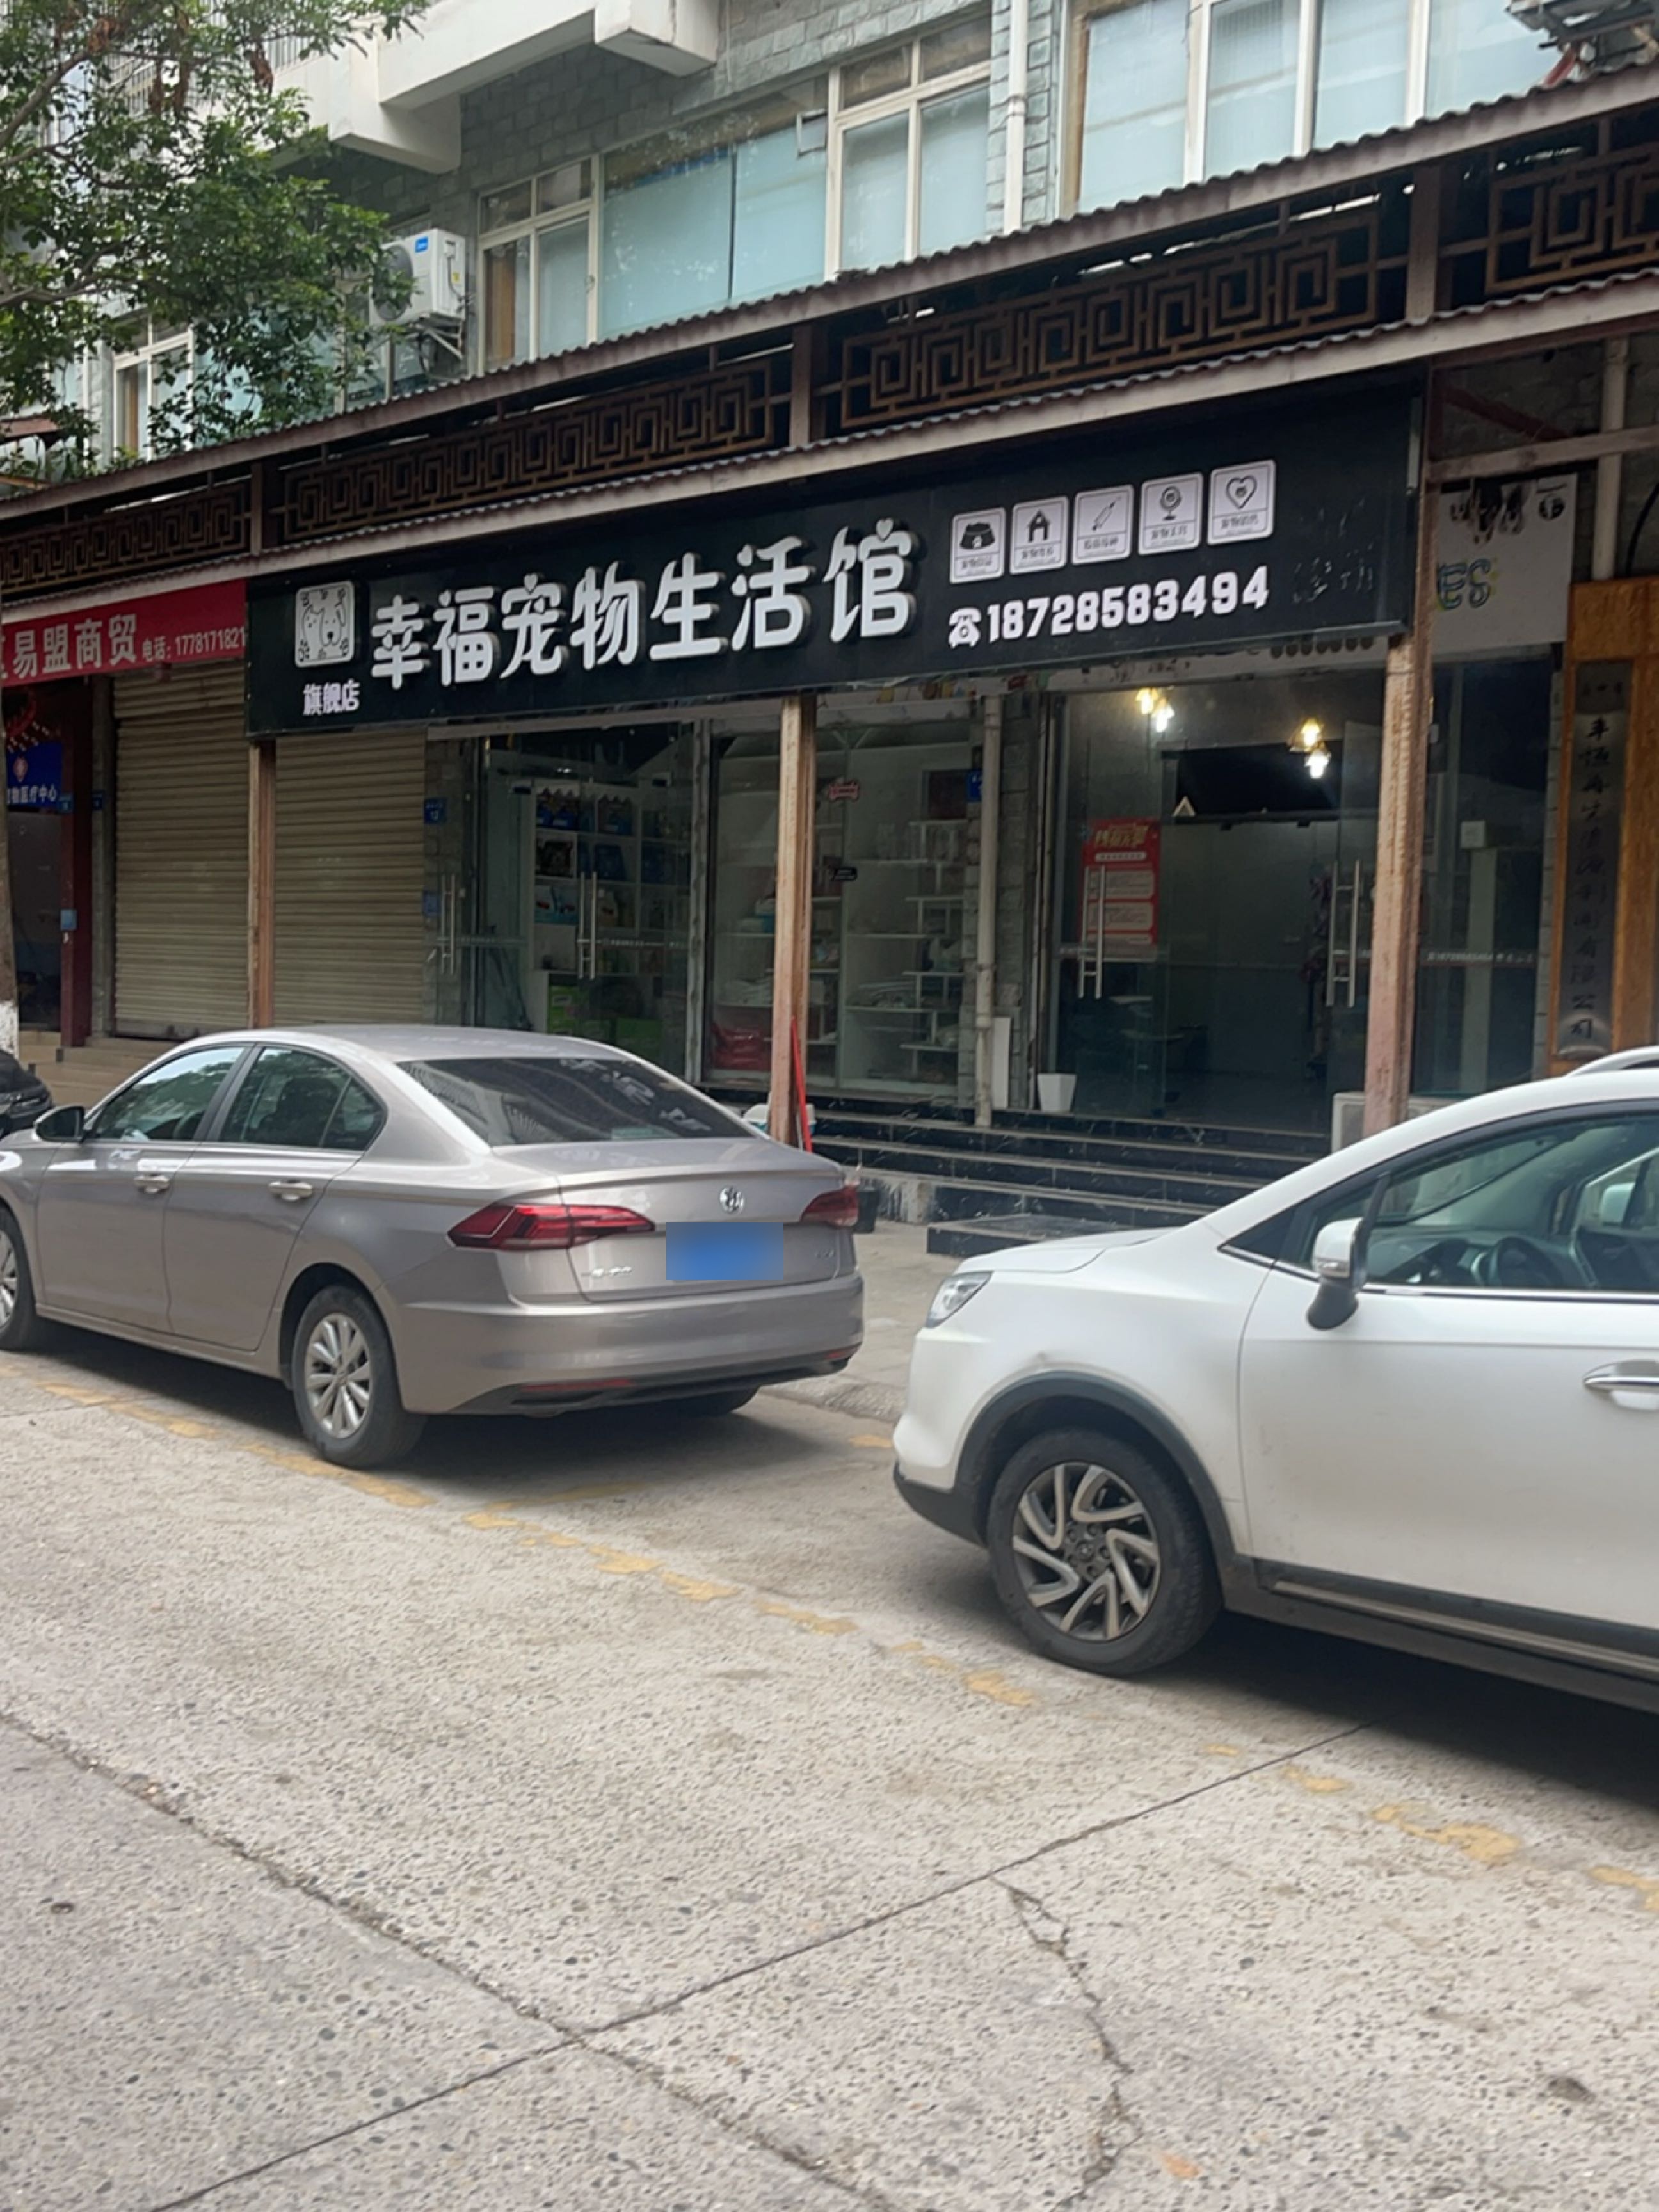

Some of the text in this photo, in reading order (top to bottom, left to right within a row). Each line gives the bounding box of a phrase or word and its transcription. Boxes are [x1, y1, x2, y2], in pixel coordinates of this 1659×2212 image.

[371, 518, 914, 689] 幸福宠物生活馆
[986, 565, 1269, 643] 18728583494
[0, 613, 138, 680] 易盟商贸
[302, 678, 360, 716] 旗舰店
